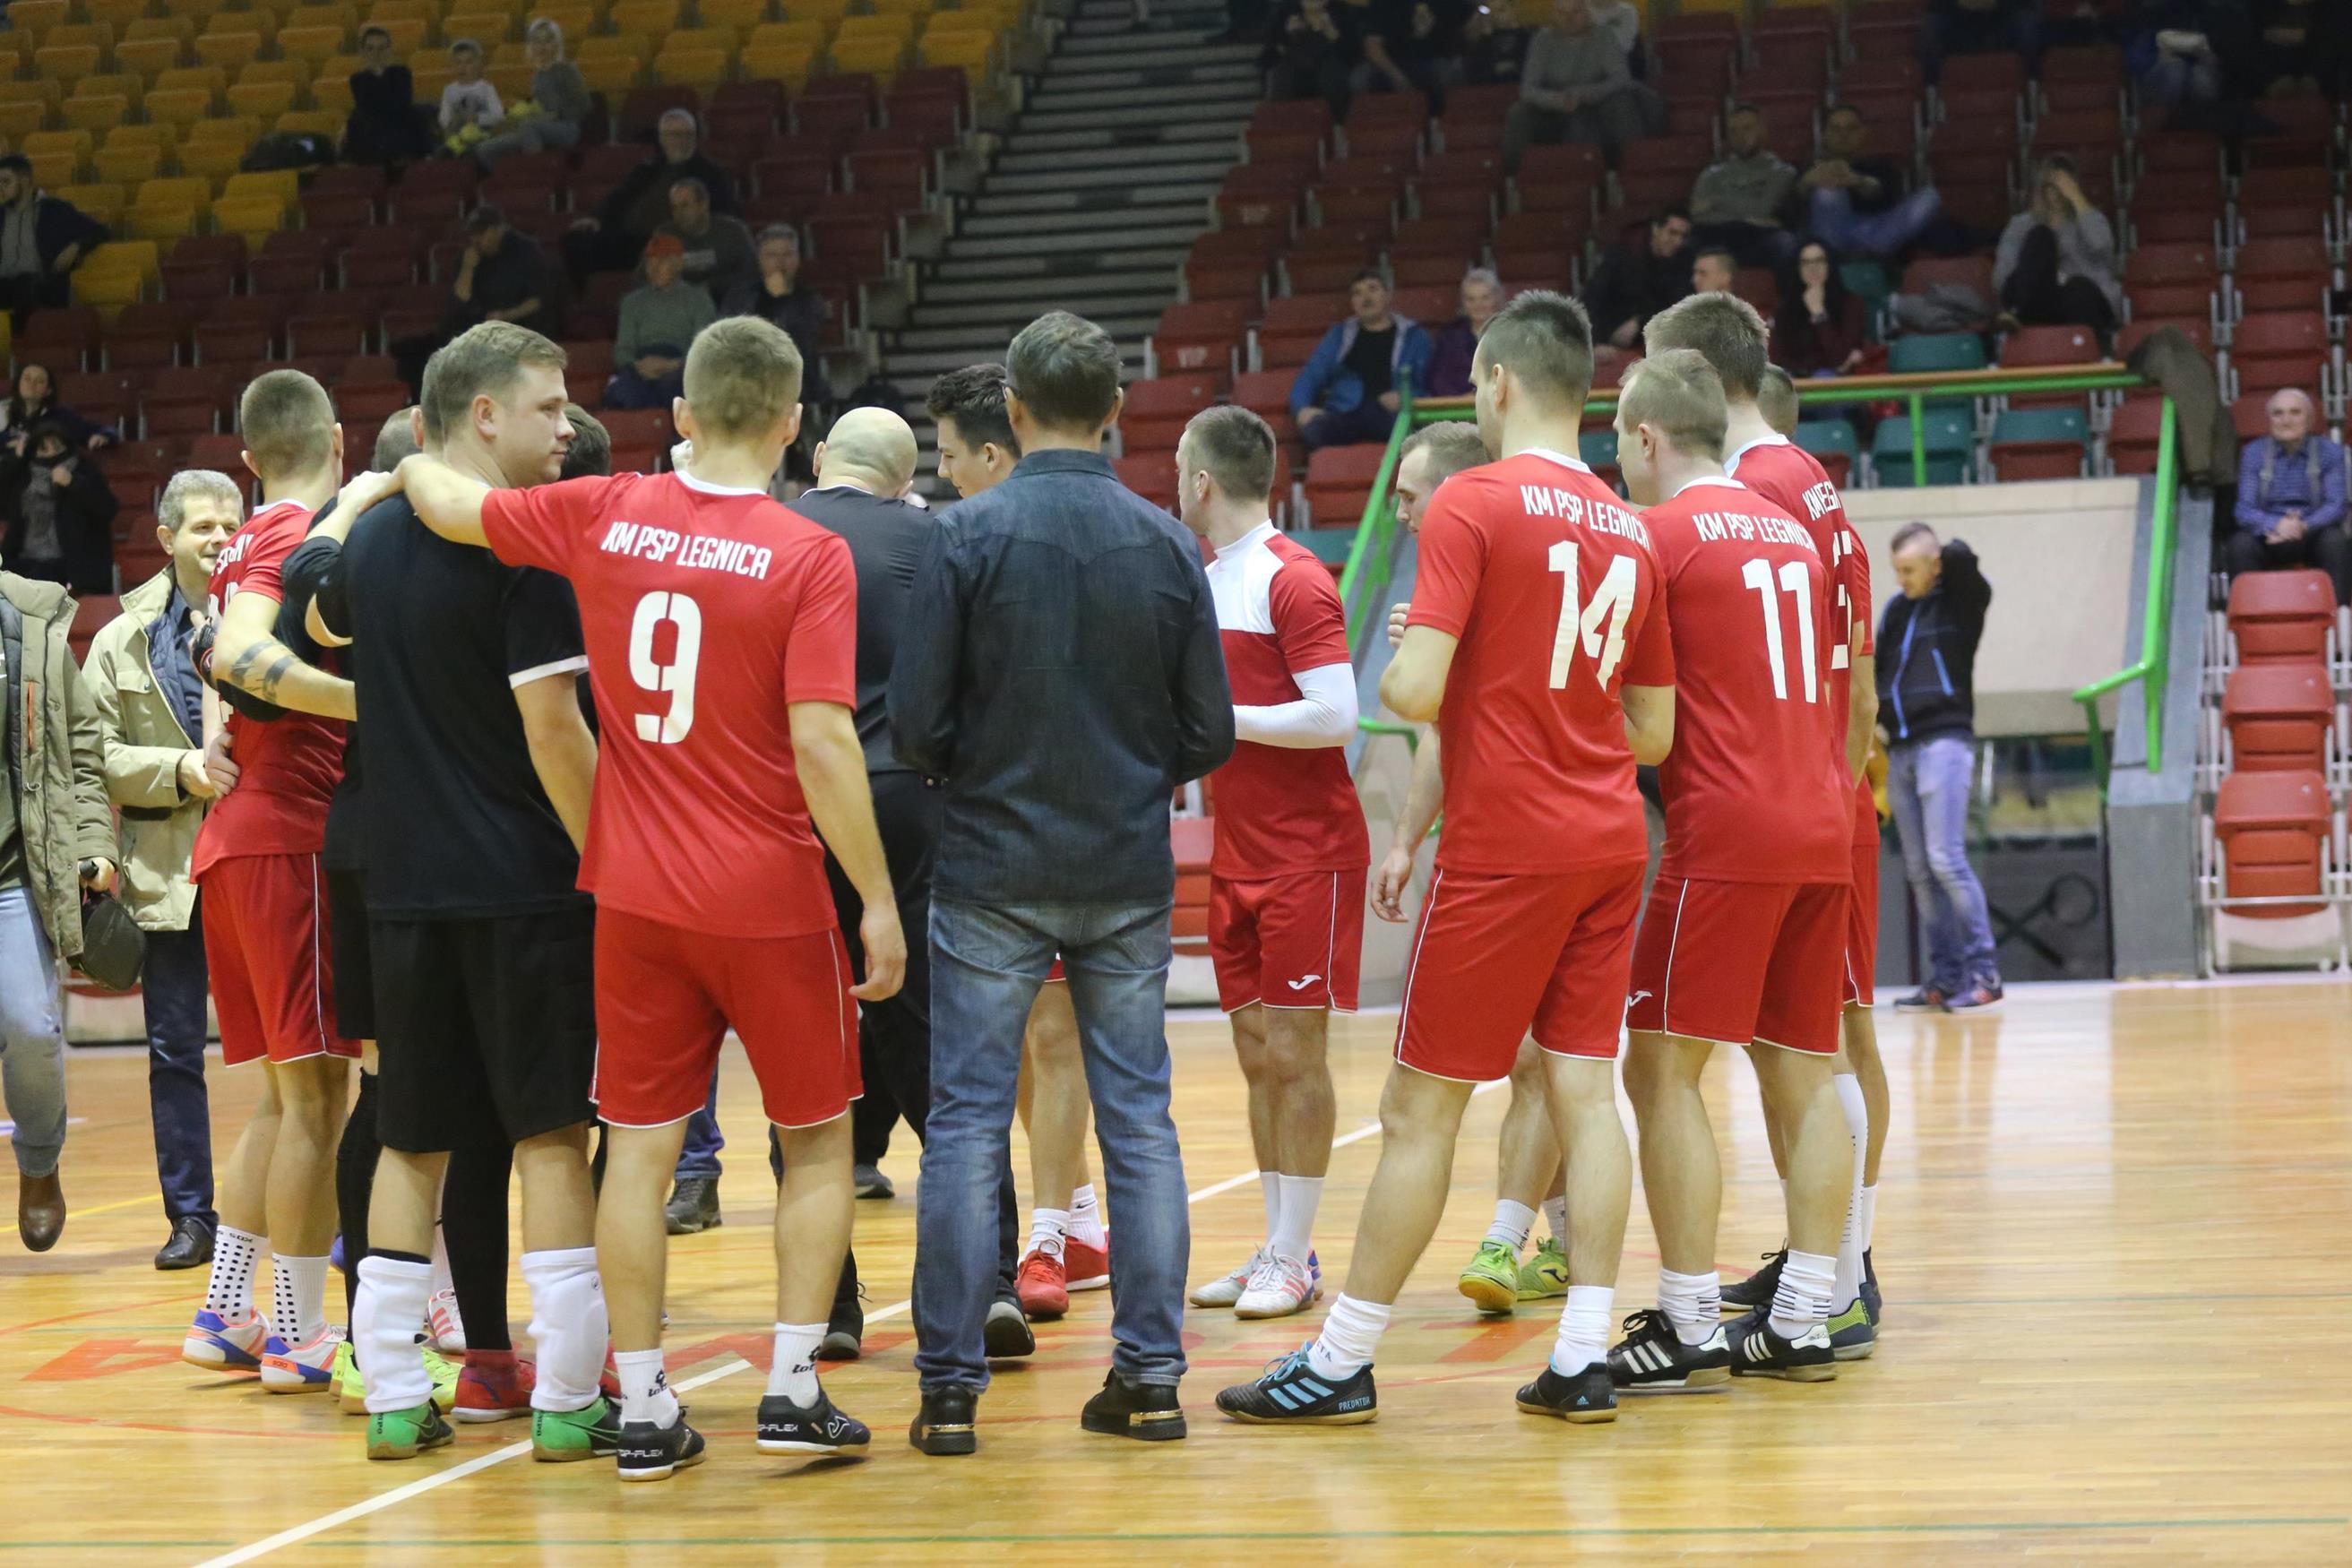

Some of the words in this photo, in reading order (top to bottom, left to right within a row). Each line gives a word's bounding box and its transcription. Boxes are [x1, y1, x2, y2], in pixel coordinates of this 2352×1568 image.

[600, 521, 640, 556] KM
[633, 525, 681, 563] PSP
[676, 534, 772, 581] LEGNICA
[1520, 485, 1555, 517] KM
[1553, 487, 1584, 526] PSP
[1585, 498, 1650, 552] LEGNICA
[1692, 512, 1728, 542] KM
[1721, 511, 1755, 541] PSP
[1547, 539, 1637, 694] 14
[1741, 557, 1817, 704] 11
[628, 590, 702, 745] 9
[1338, 1396, 1372, 1412] PREDATOR
